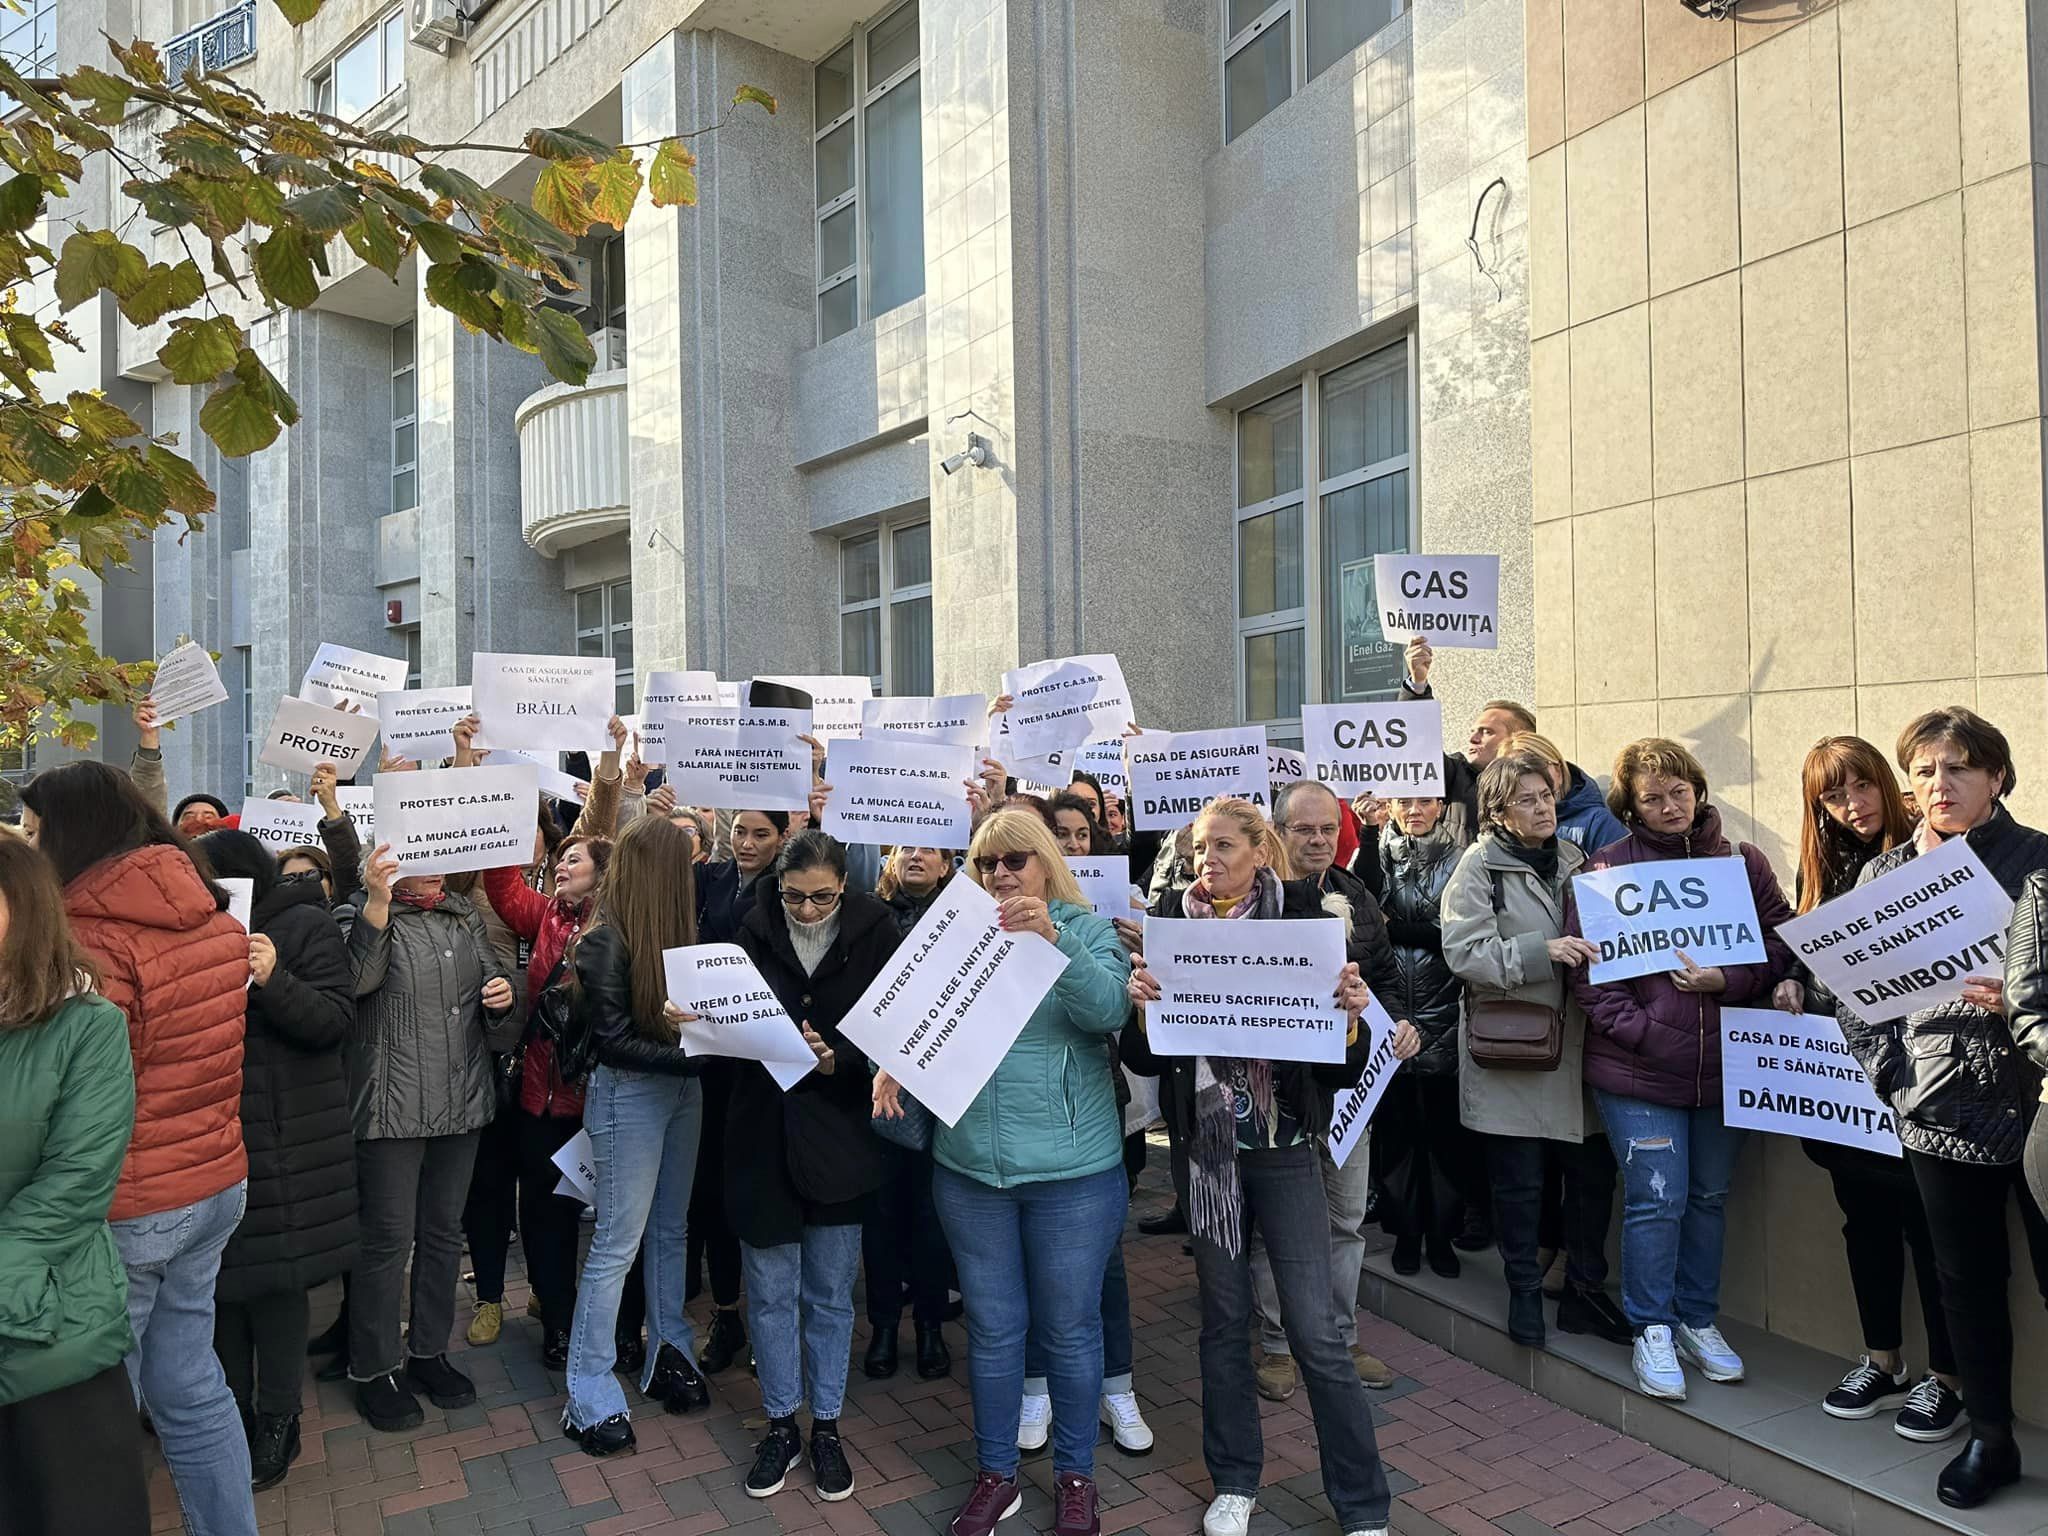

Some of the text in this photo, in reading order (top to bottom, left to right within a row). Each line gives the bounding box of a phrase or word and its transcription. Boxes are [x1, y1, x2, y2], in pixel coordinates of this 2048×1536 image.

[1400, 570, 1468, 599] CAS
[1353, 641, 1394, 657] Enel Gaz
[322, 660, 351, 672] PROTEST
[501, 666, 525, 674] CASA
[526, 666, 537, 674] DE
[310, 679, 329, 689] VREM
[1022, 683, 1061, 698] PROTEST
[395, 707, 432, 716] PROTEST
[516, 700, 577, 715] BRĂILA
[1018, 713, 1043, 726] VREM
[1045, 707, 1079, 721] SALARII
[1081, 698, 1122, 713] DECENTE
[688, 717, 790, 728] PROTEST C.A.S.M.B.
[883, 722, 925, 730] PROTEST
[389, 730, 413, 740] VREM
[414, 729, 446, 737] SALARII
[1334, 718, 1408, 749] CAS
[279, 732, 360, 760] PROTEST
[1133, 744, 1259, 764] CASA DE ASIGURĂRI
[678, 759, 802, 771] SALARIALE ÎN SISTEMUL
[849, 765, 950, 779] PROTEST C.A.S.M.B.
[1155, 765, 1241, 781] DE SĂNĂTATE
[719, 774, 759, 783] PUBLIC!
[399, 792, 515, 810] PROTEST C.A.S.M.B.
[851, 797, 864, 806] LA
[840, 812, 953, 827] VREM SALARII EGALE!
[249, 826, 323, 846] PROTEST
[407, 834, 422, 844] LA
[397, 839, 518, 862] VREM SALARII EGALE!
[1614, 877, 1709, 917] CAS
[1800, 865, 1975, 955] CASA DE ASIGURĂRI
[1842, 904, 1965, 967] DE SĂNĂTATE
[519, 942, 529, 965] LIFE
[1174, 954, 1314, 967] PROTEST C.A.S.M.B.
[696, 956, 747, 969] PROTEST
[873, 908, 960, 1018] PROTEST C.A.S.M.B.
[899, 924, 1000, 1056] VREM O LEGE UNITARĂ
[690, 991, 773, 1010] VREM O LEGE
[917, 939, 1015, 1070] PRIVIND SALARIZAREA
[1173, 993, 1221, 1004] MEREU
[1161, 1014, 1237, 1026] NICIODATĂ
[1729, 1031, 1774, 1045] CASA
[1779, 1034, 1800, 1048] DE
[1757, 1056, 1865, 1084] DE SĂNĂTATE
